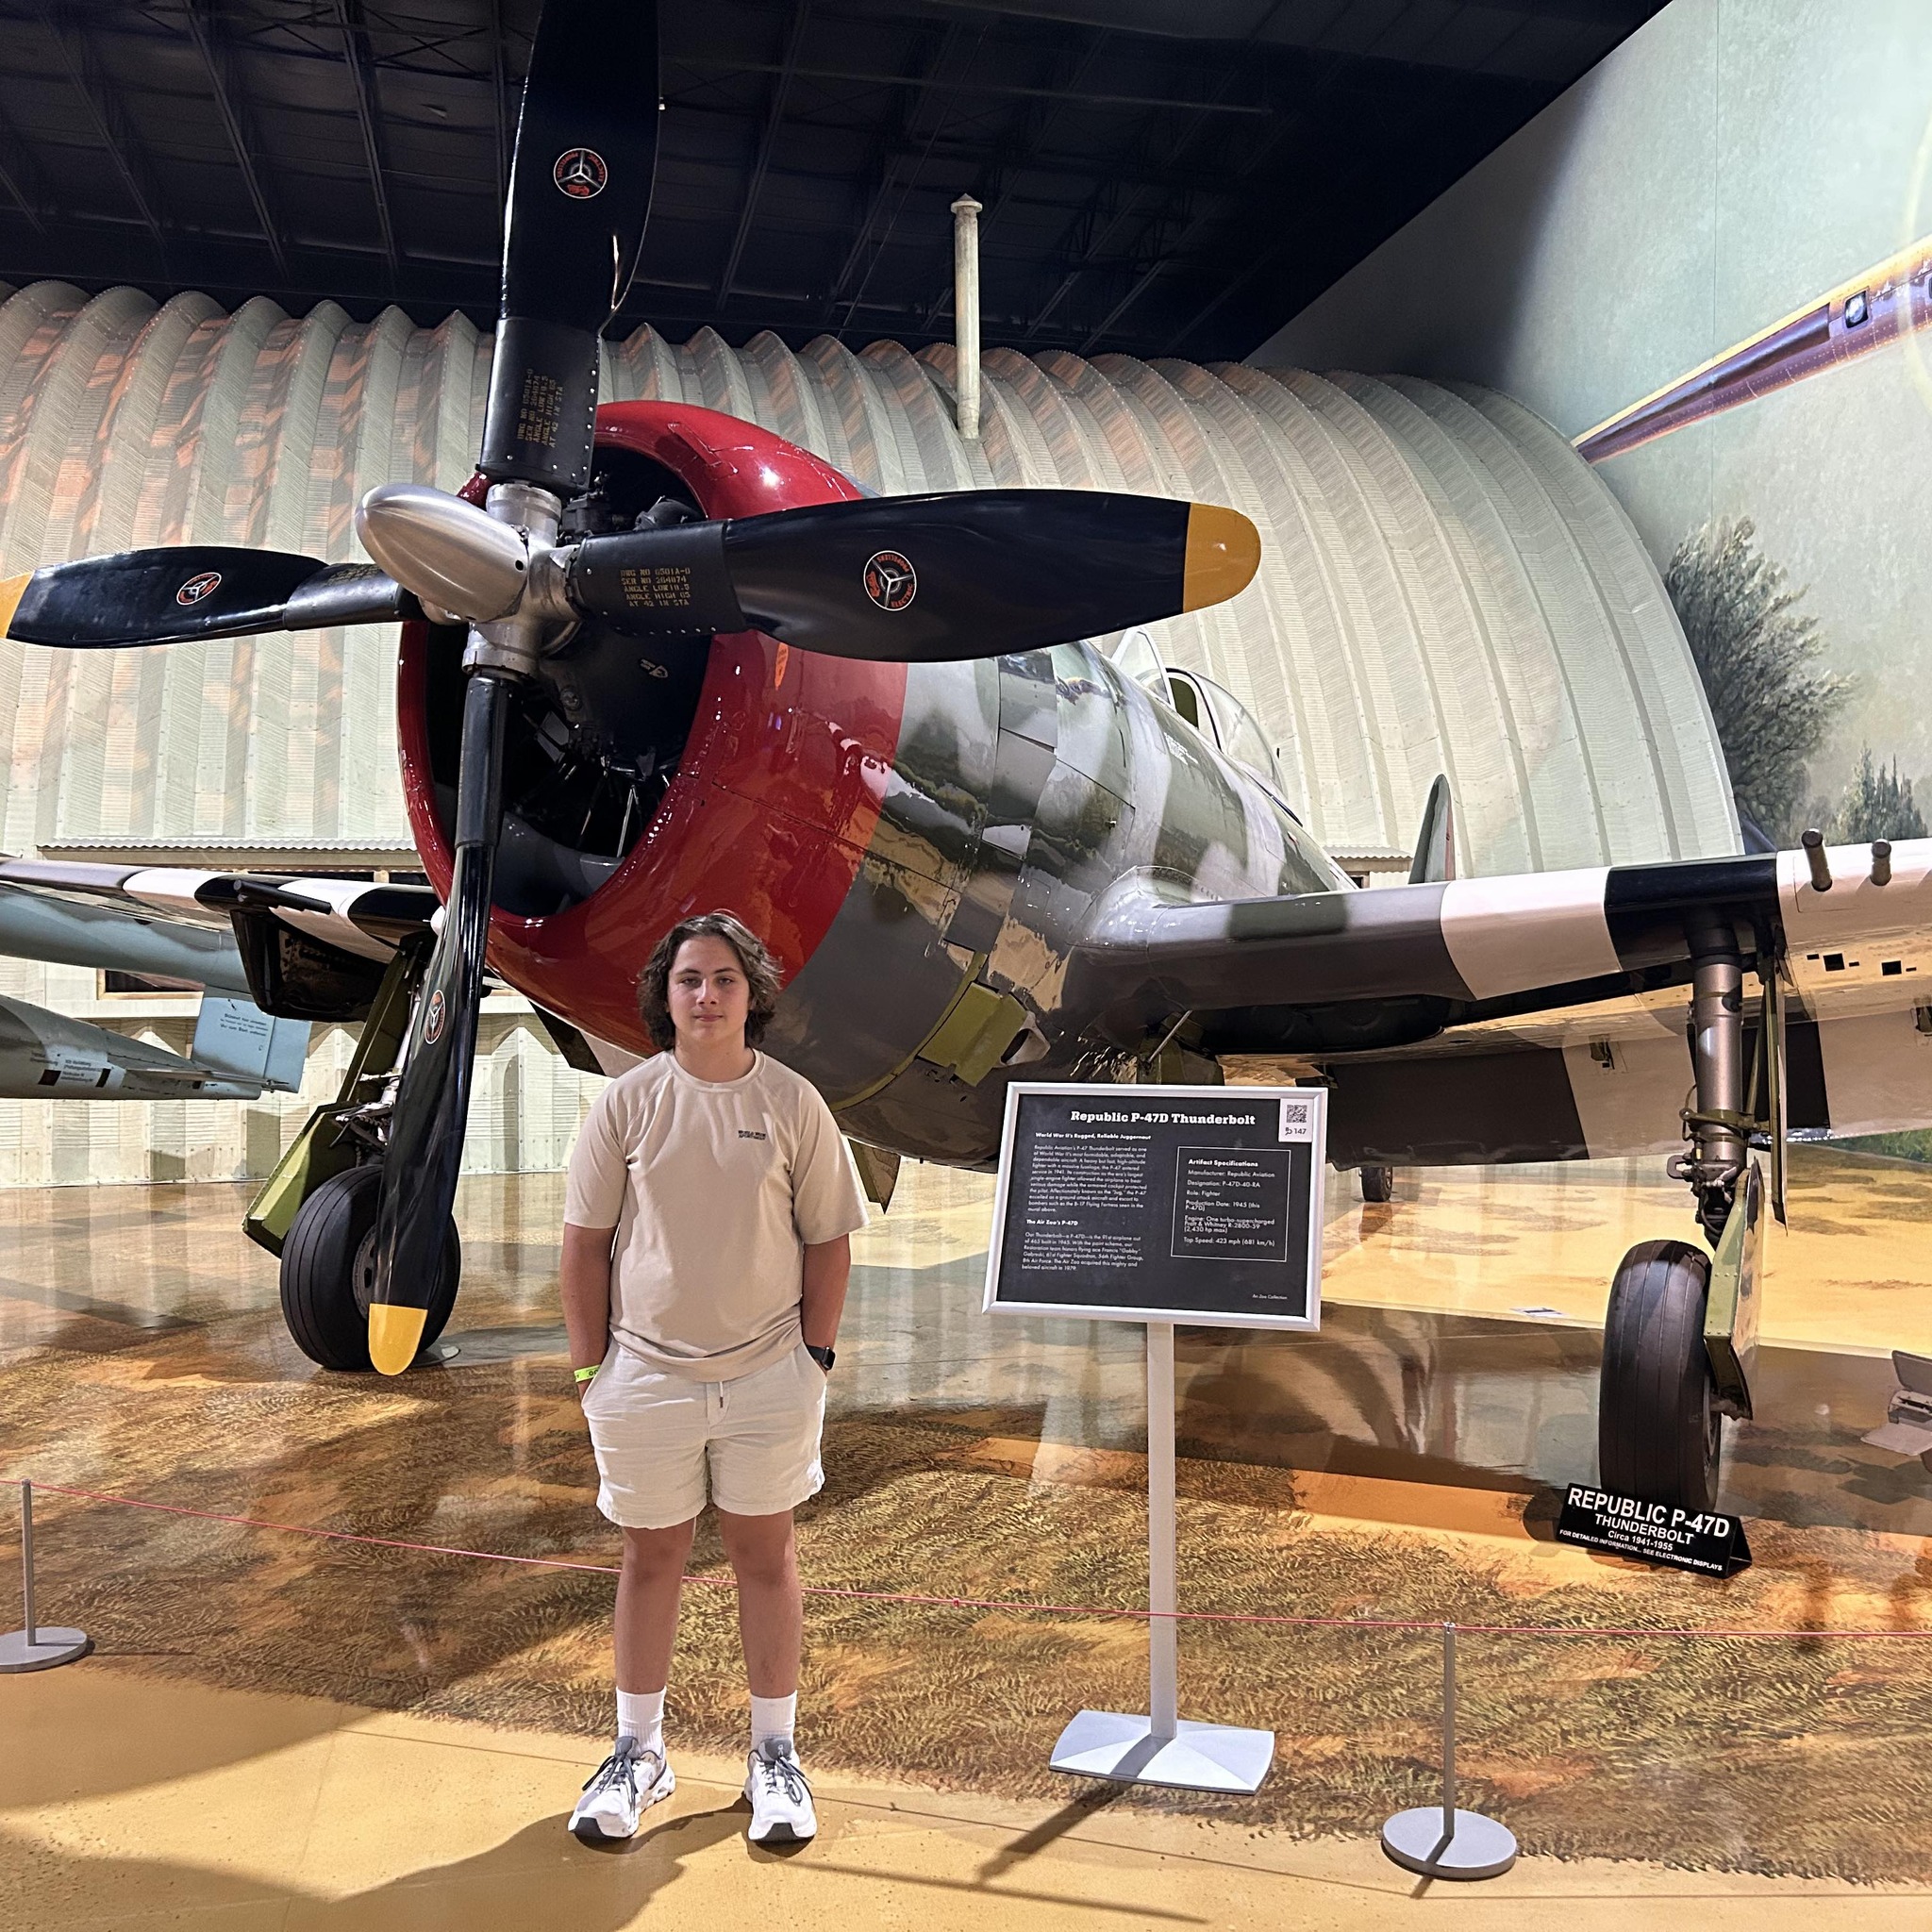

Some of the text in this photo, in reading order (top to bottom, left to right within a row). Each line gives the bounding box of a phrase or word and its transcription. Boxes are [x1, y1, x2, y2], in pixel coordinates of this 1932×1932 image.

[520, 409, 527, 419] NO
[541, 420, 550, 445] ANGLE
[546, 394, 554, 415] HIGH
[553, 406, 560, 416] IN
[533, 417, 543, 442] ANGLE
[552, 422, 558, 432] 42
[549, 436, 556, 447] AT
[891, 583, 913, 608] ELECTRIC
[1071, 1111, 1255, 1125] Republic P-47D Thunderbolt
[1567, 1487, 1730, 1537] REPUBLIC P-47D
[1595, 1514, 1694, 1545] THUNDERBOLT
[1608, 1530, 1673, 1551] Circa 1941-1955
[1572, 1531, 1598, 1543] DETAILED
[1655, 1551, 1692, 1564] ELECTRONIC
[1693, 1559, 1722, 1571] DISPLAYS
